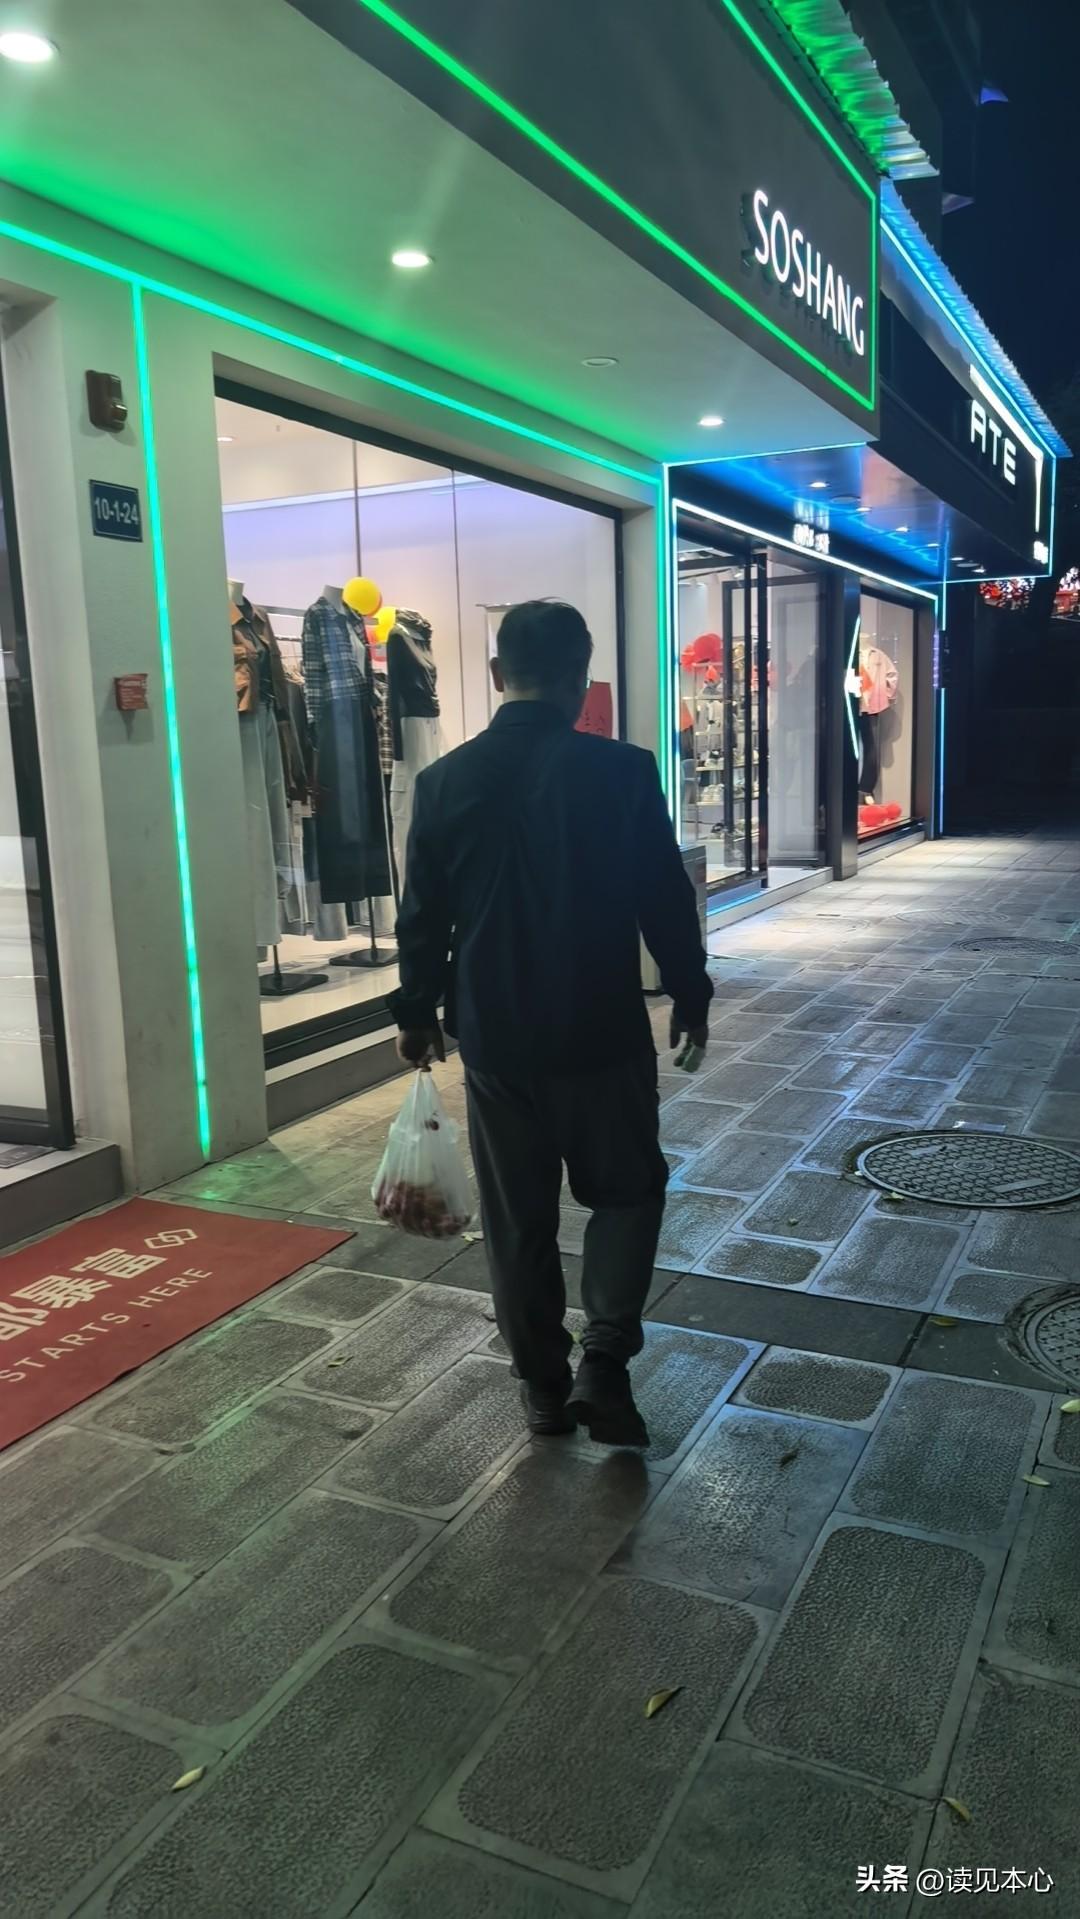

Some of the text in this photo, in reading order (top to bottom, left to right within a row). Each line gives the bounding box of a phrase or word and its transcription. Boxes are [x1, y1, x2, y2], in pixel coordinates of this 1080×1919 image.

[754, 190, 864, 355] SOSHANG
[971, 399, 1016, 485] ATE
[95, 496, 139, 525] 10-1-24
[0, 1268, 213, 1383] STARTS HERE
